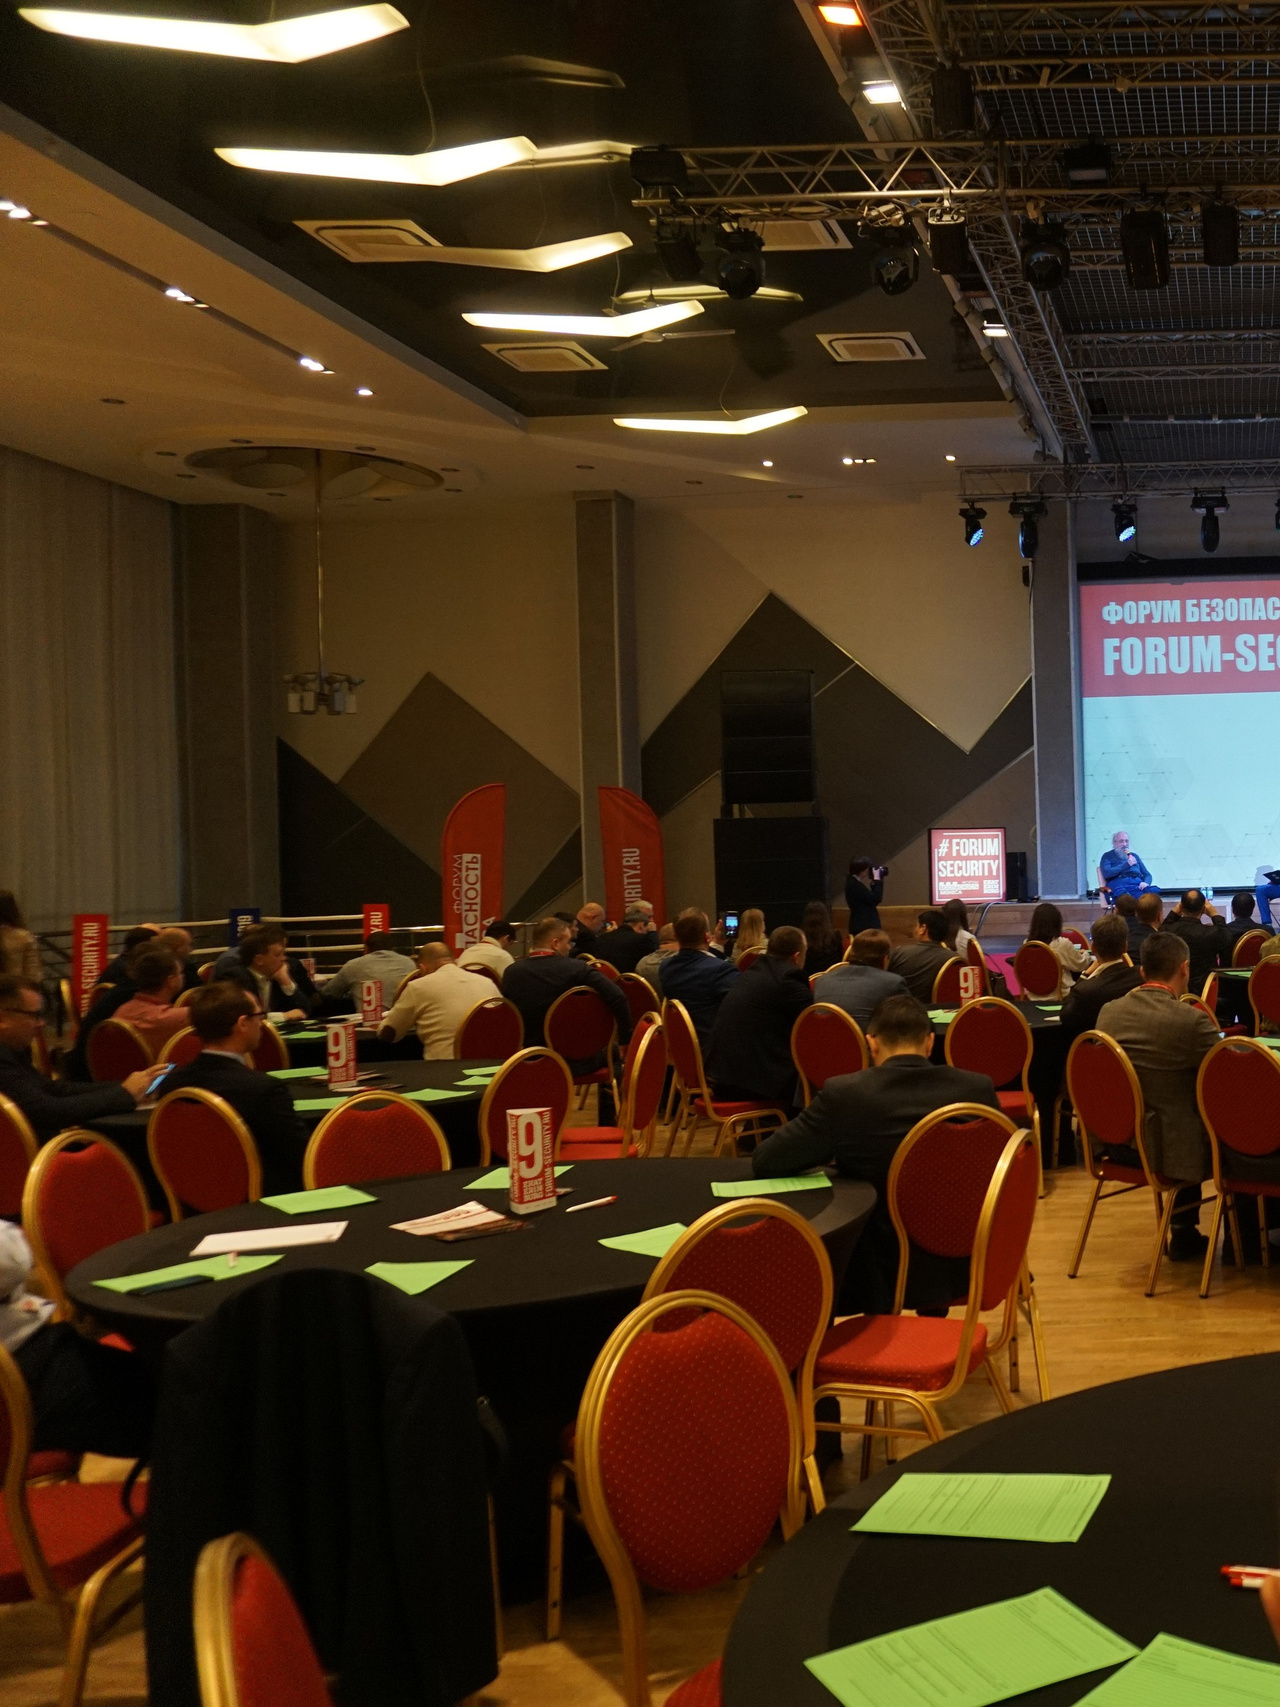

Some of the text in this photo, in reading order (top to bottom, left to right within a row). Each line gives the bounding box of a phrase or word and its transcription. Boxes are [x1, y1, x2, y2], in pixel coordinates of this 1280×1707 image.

[1102, 600, 1181, 625] ФОРУМ
[952, 838, 998, 857] FORUM
[452, 854, 462, 914] ФОРУМ
[938, 860, 999, 877] SECURITY
[362, 982, 376, 1011] 9
[959, 967, 974, 998] 9
[327, 1026, 347, 1067] 9
[518, 1112, 543, 1179] 9
[543, 1111, 553, 1197] FORUM-SECURITY.RU
